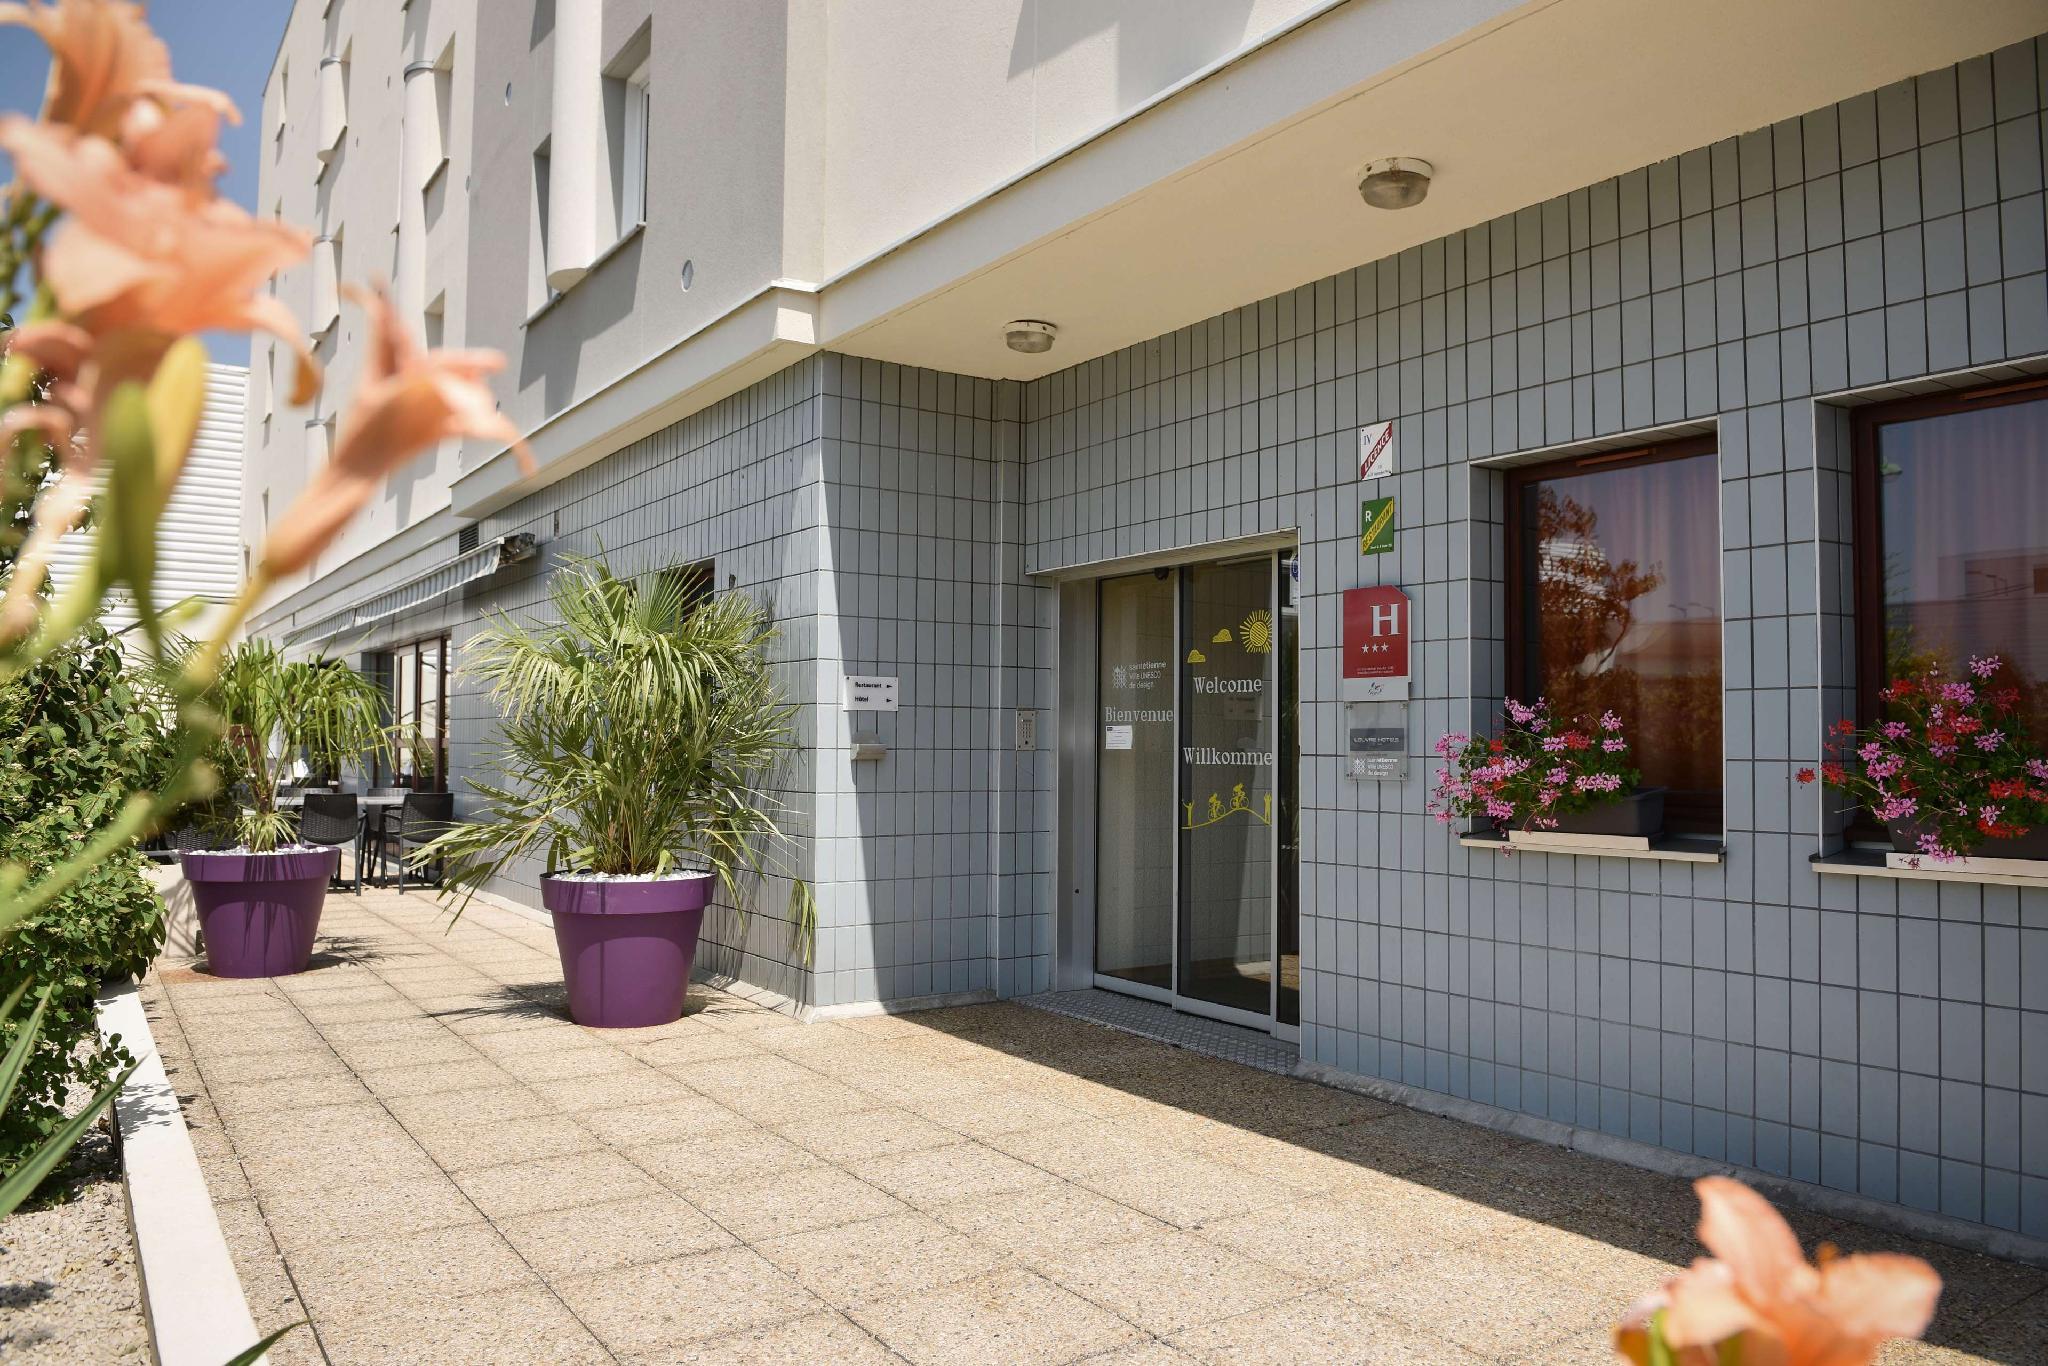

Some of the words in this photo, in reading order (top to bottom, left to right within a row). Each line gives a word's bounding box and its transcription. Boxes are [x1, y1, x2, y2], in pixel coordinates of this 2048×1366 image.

[1363, 434, 1372, 446] IV
[1364, 429, 1390, 472] LICENCE
[1362, 499, 1393, 551] RESTAURANT
[1365, 510, 1372, 523] R
[1369, 603, 1401, 637] H
[1193, 676, 1262, 694] Welcome
[1105, 705, 1174, 722] Bienvenue
